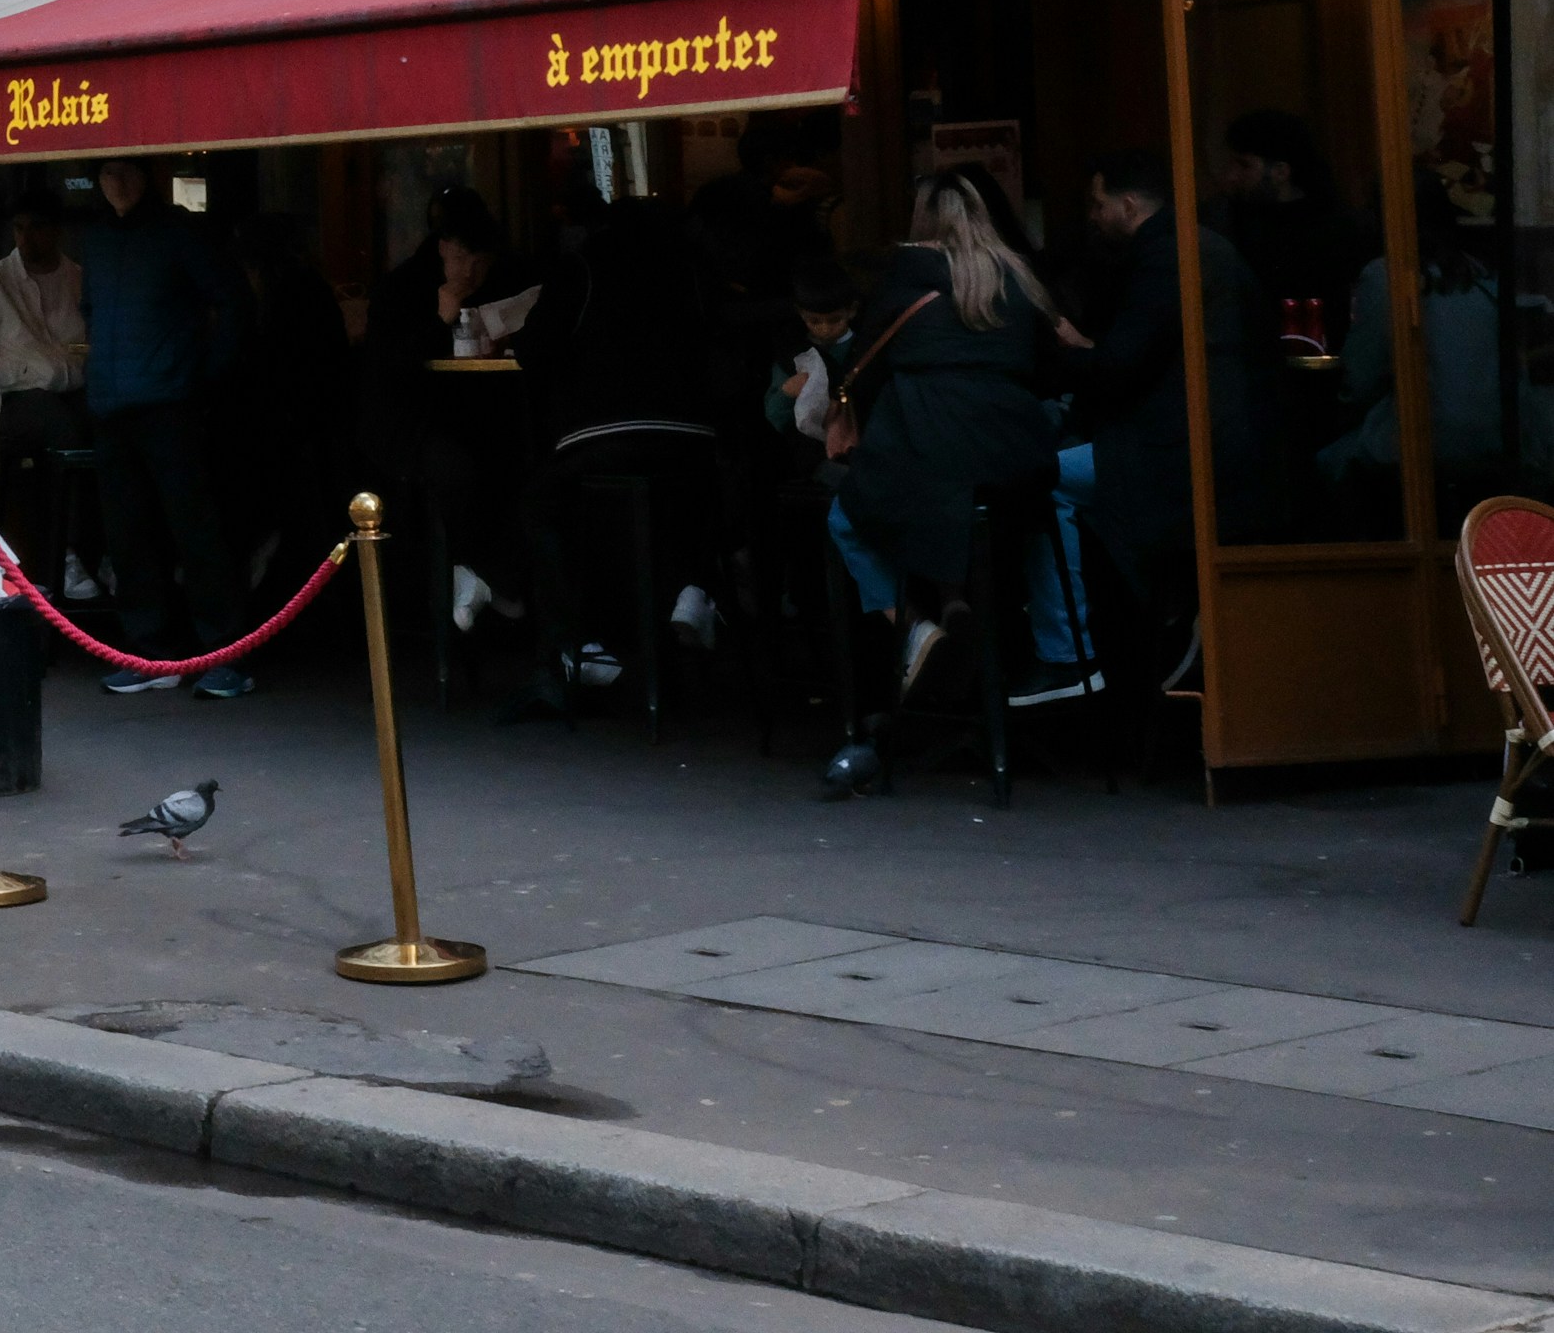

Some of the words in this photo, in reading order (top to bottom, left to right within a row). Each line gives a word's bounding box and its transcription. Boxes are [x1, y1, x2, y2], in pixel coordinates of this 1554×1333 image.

[546, 33, 570, 88] à
[580, 15, 778, 100] emporter
[6, 77, 110, 145] Relais
